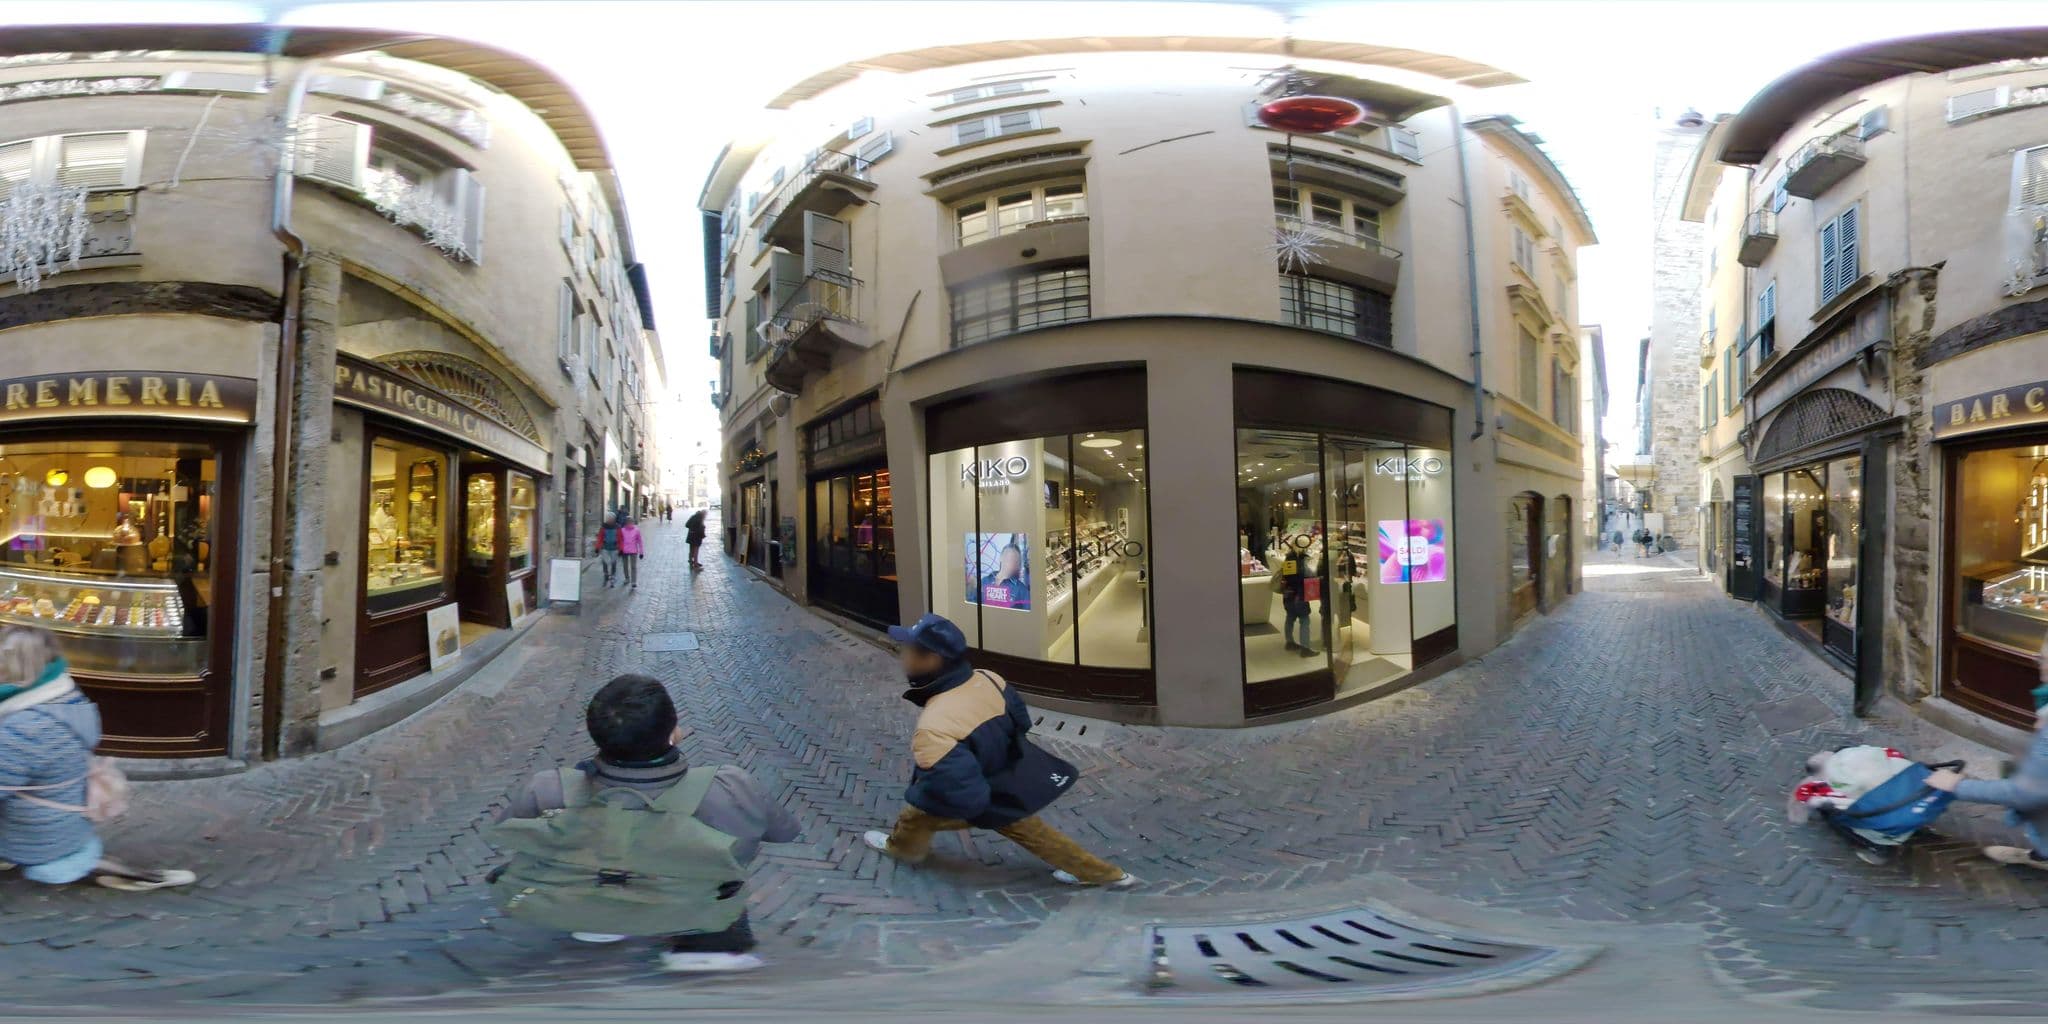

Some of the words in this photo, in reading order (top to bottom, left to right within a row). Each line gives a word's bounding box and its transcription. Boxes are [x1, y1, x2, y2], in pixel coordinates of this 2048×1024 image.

[6, 376, 224, 409] REMERIA
[336, 365, 460, 427] PASTICCERIA
[1951, 394, 2012, 426] BAR
[961, 456, 1028, 480] KIKO
[1376, 457, 1444, 475] KIKO
[1078, 540, 1143, 558] KIKO
